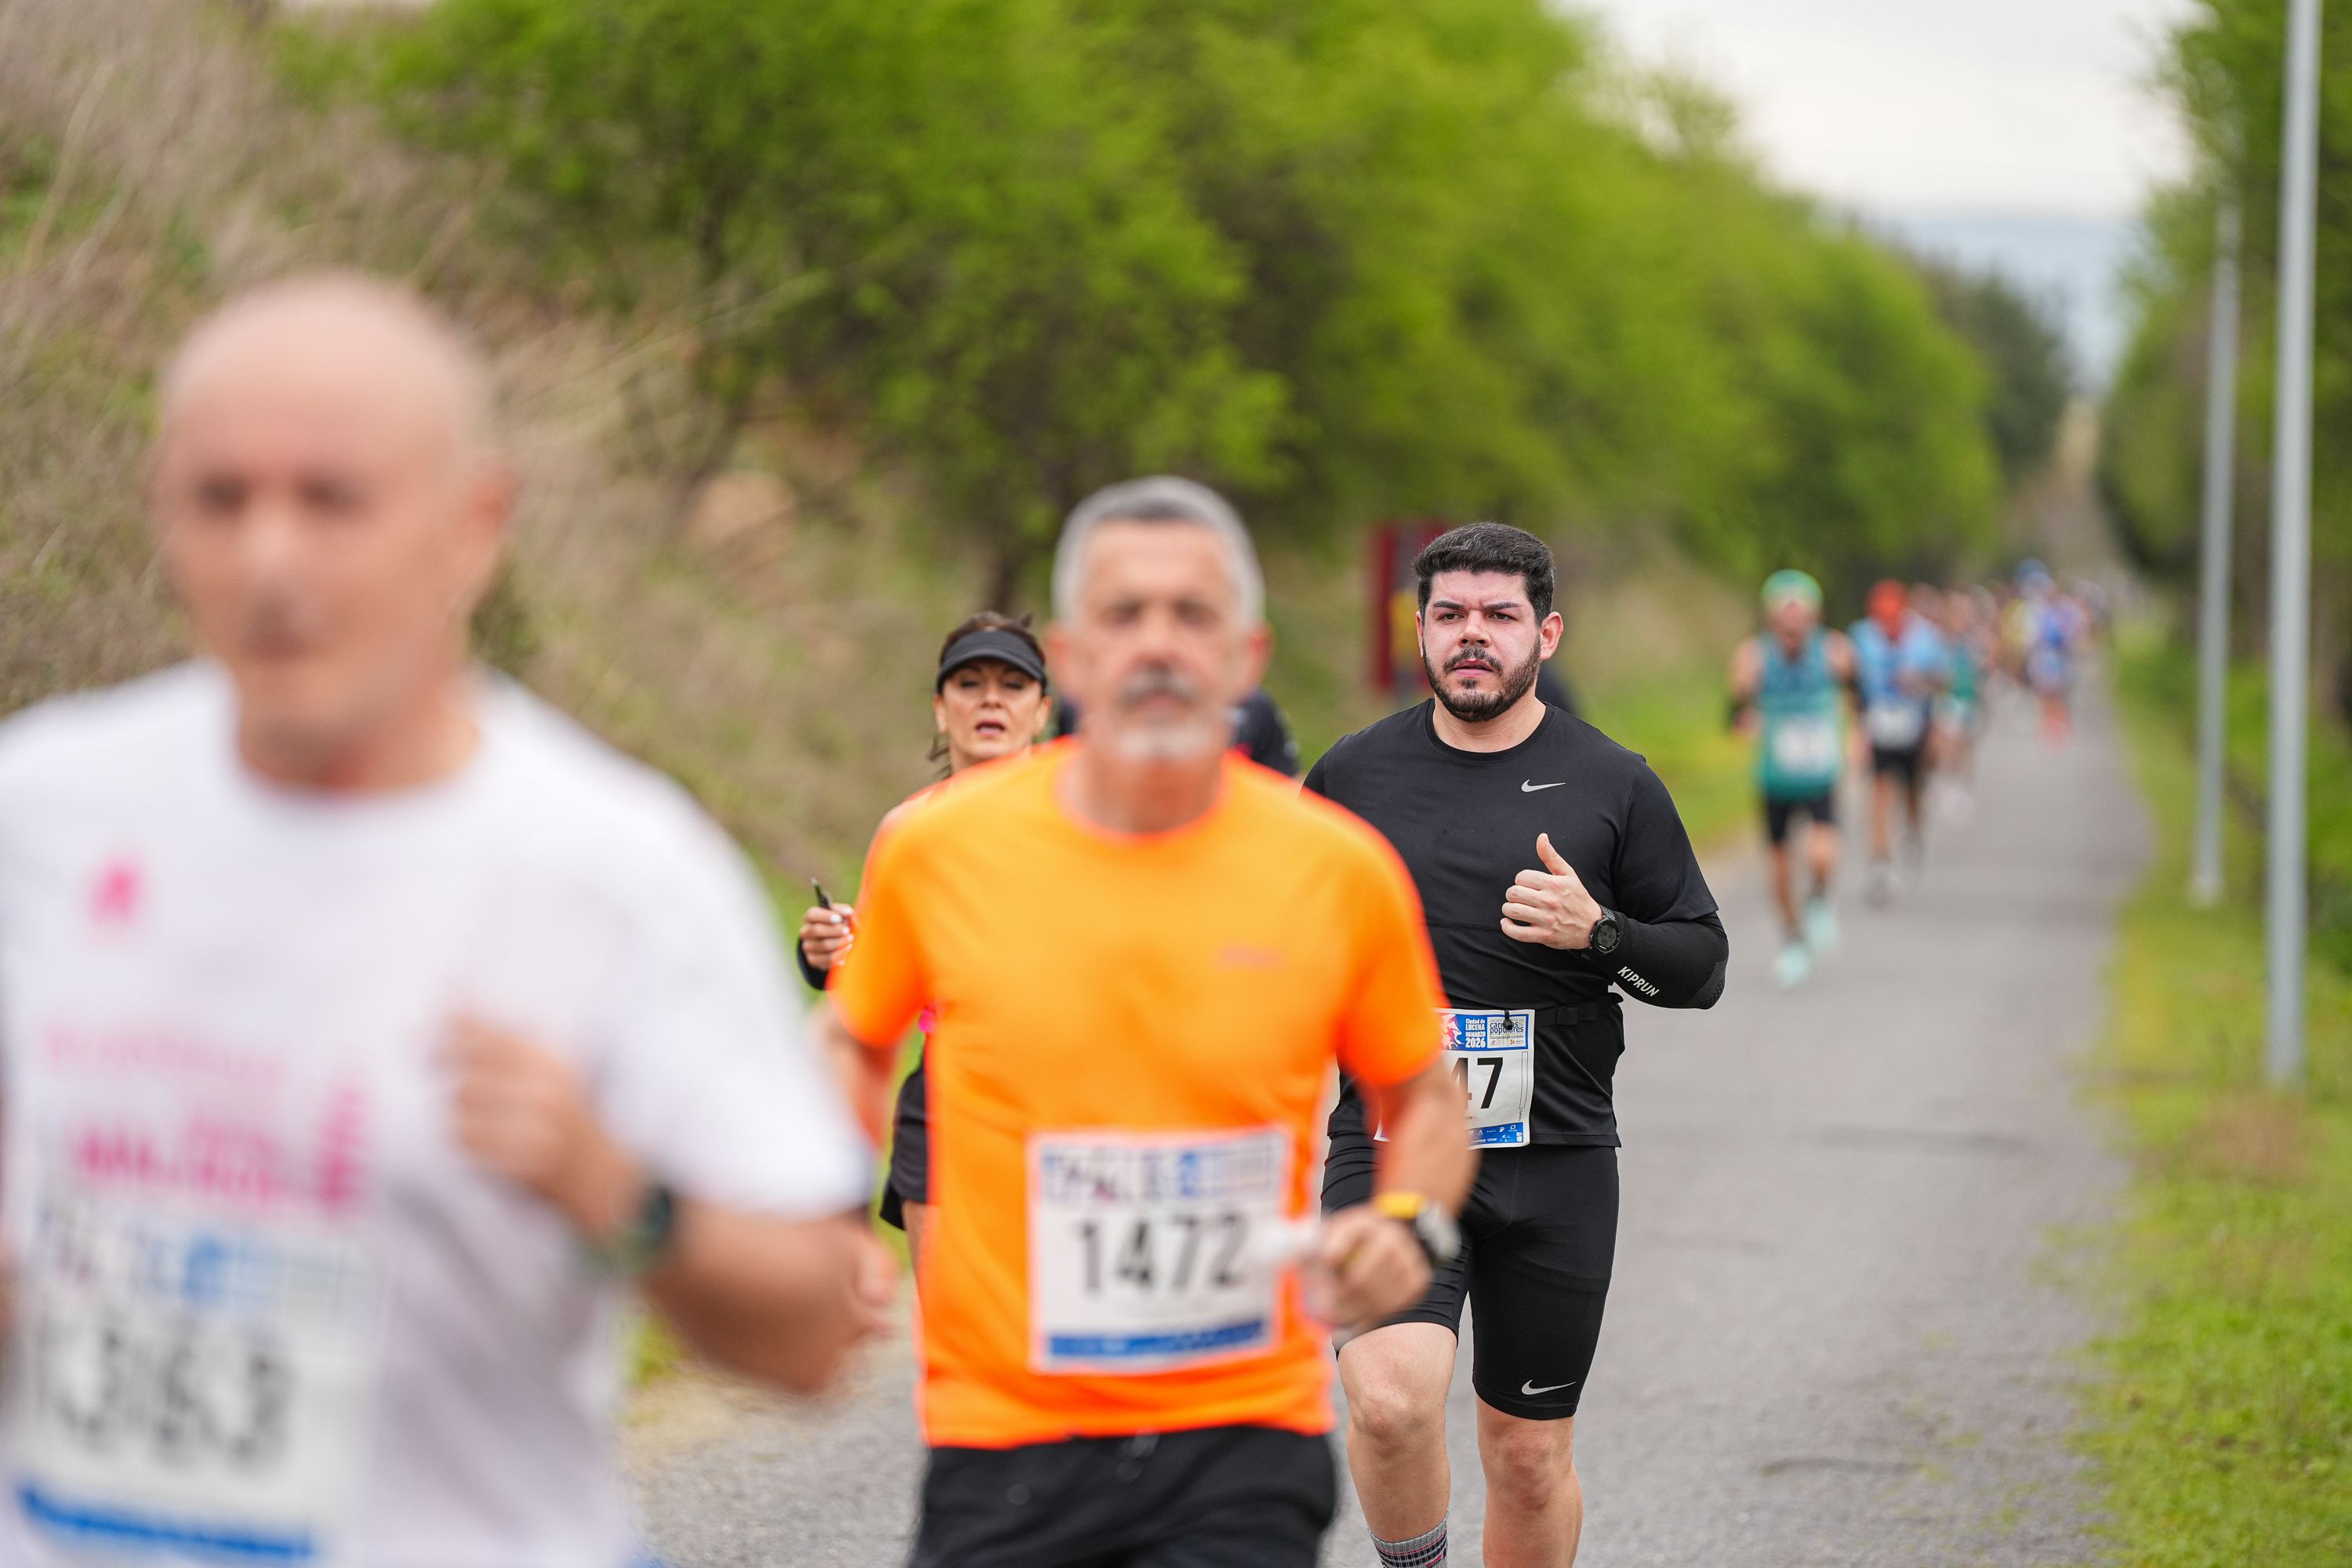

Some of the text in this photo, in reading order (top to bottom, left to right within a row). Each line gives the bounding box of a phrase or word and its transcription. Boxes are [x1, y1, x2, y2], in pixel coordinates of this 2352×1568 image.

[1617, 966, 1660, 997] KIPRUN
[1465, 1037, 1486, 1048] 2026
[1078, 1214, 1250, 1298] 1472
